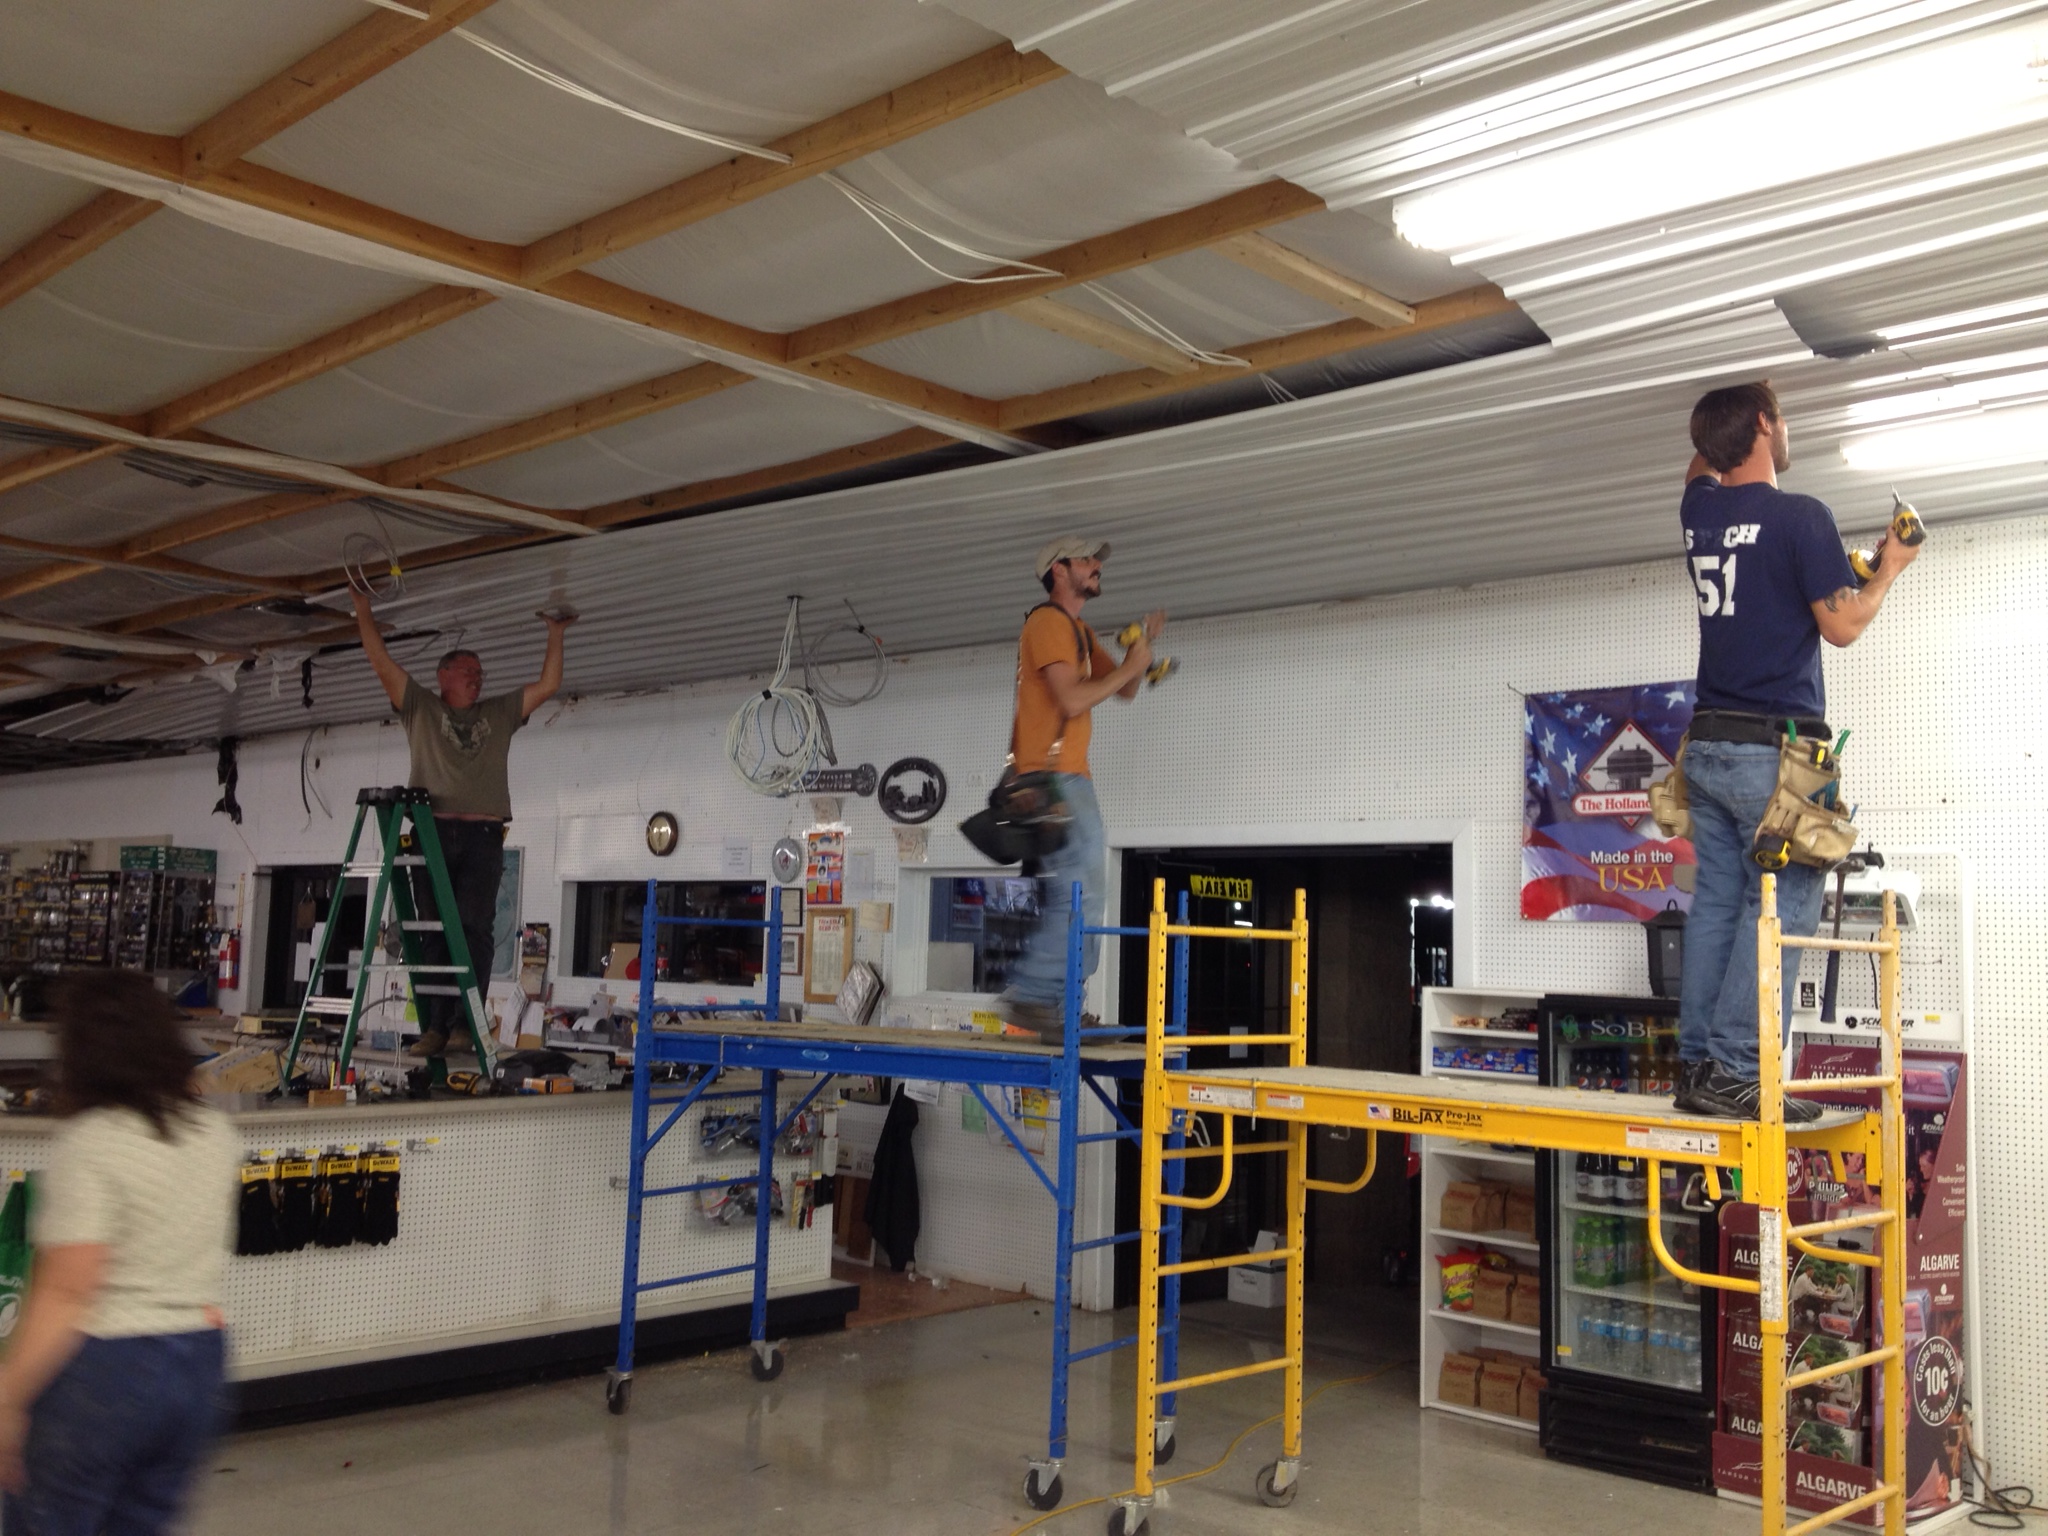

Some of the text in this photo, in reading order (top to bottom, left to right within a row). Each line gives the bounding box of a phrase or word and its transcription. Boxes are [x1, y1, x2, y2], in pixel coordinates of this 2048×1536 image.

[1692, 554, 1736, 616] 51
[1581, 799, 1602, 811] The
[1591, 849, 1674, 865] Made in the
[1598, 866, 1667, 892] USA
[1393, 1107, 1482, 1124] BIL-JAX Pro-Jax
[285, 1164, 309, 1172] DEWALT
[330, 1161, 353, 1170] DEWALT
[373, 1158, 396, 1167] DEWALT
[1788, 1160, 1798, 1178] 0¢
[1920, 1254, 1960, 1271] ALGARVE
[1916, 1342, 1956, 1382] Costs less than
[1924, 1366, 1949, 1396] 10¢
[1920, 1392, 1955, 1421] for an hour
[1796, 1471, 1867, 1500] ALGARVE
